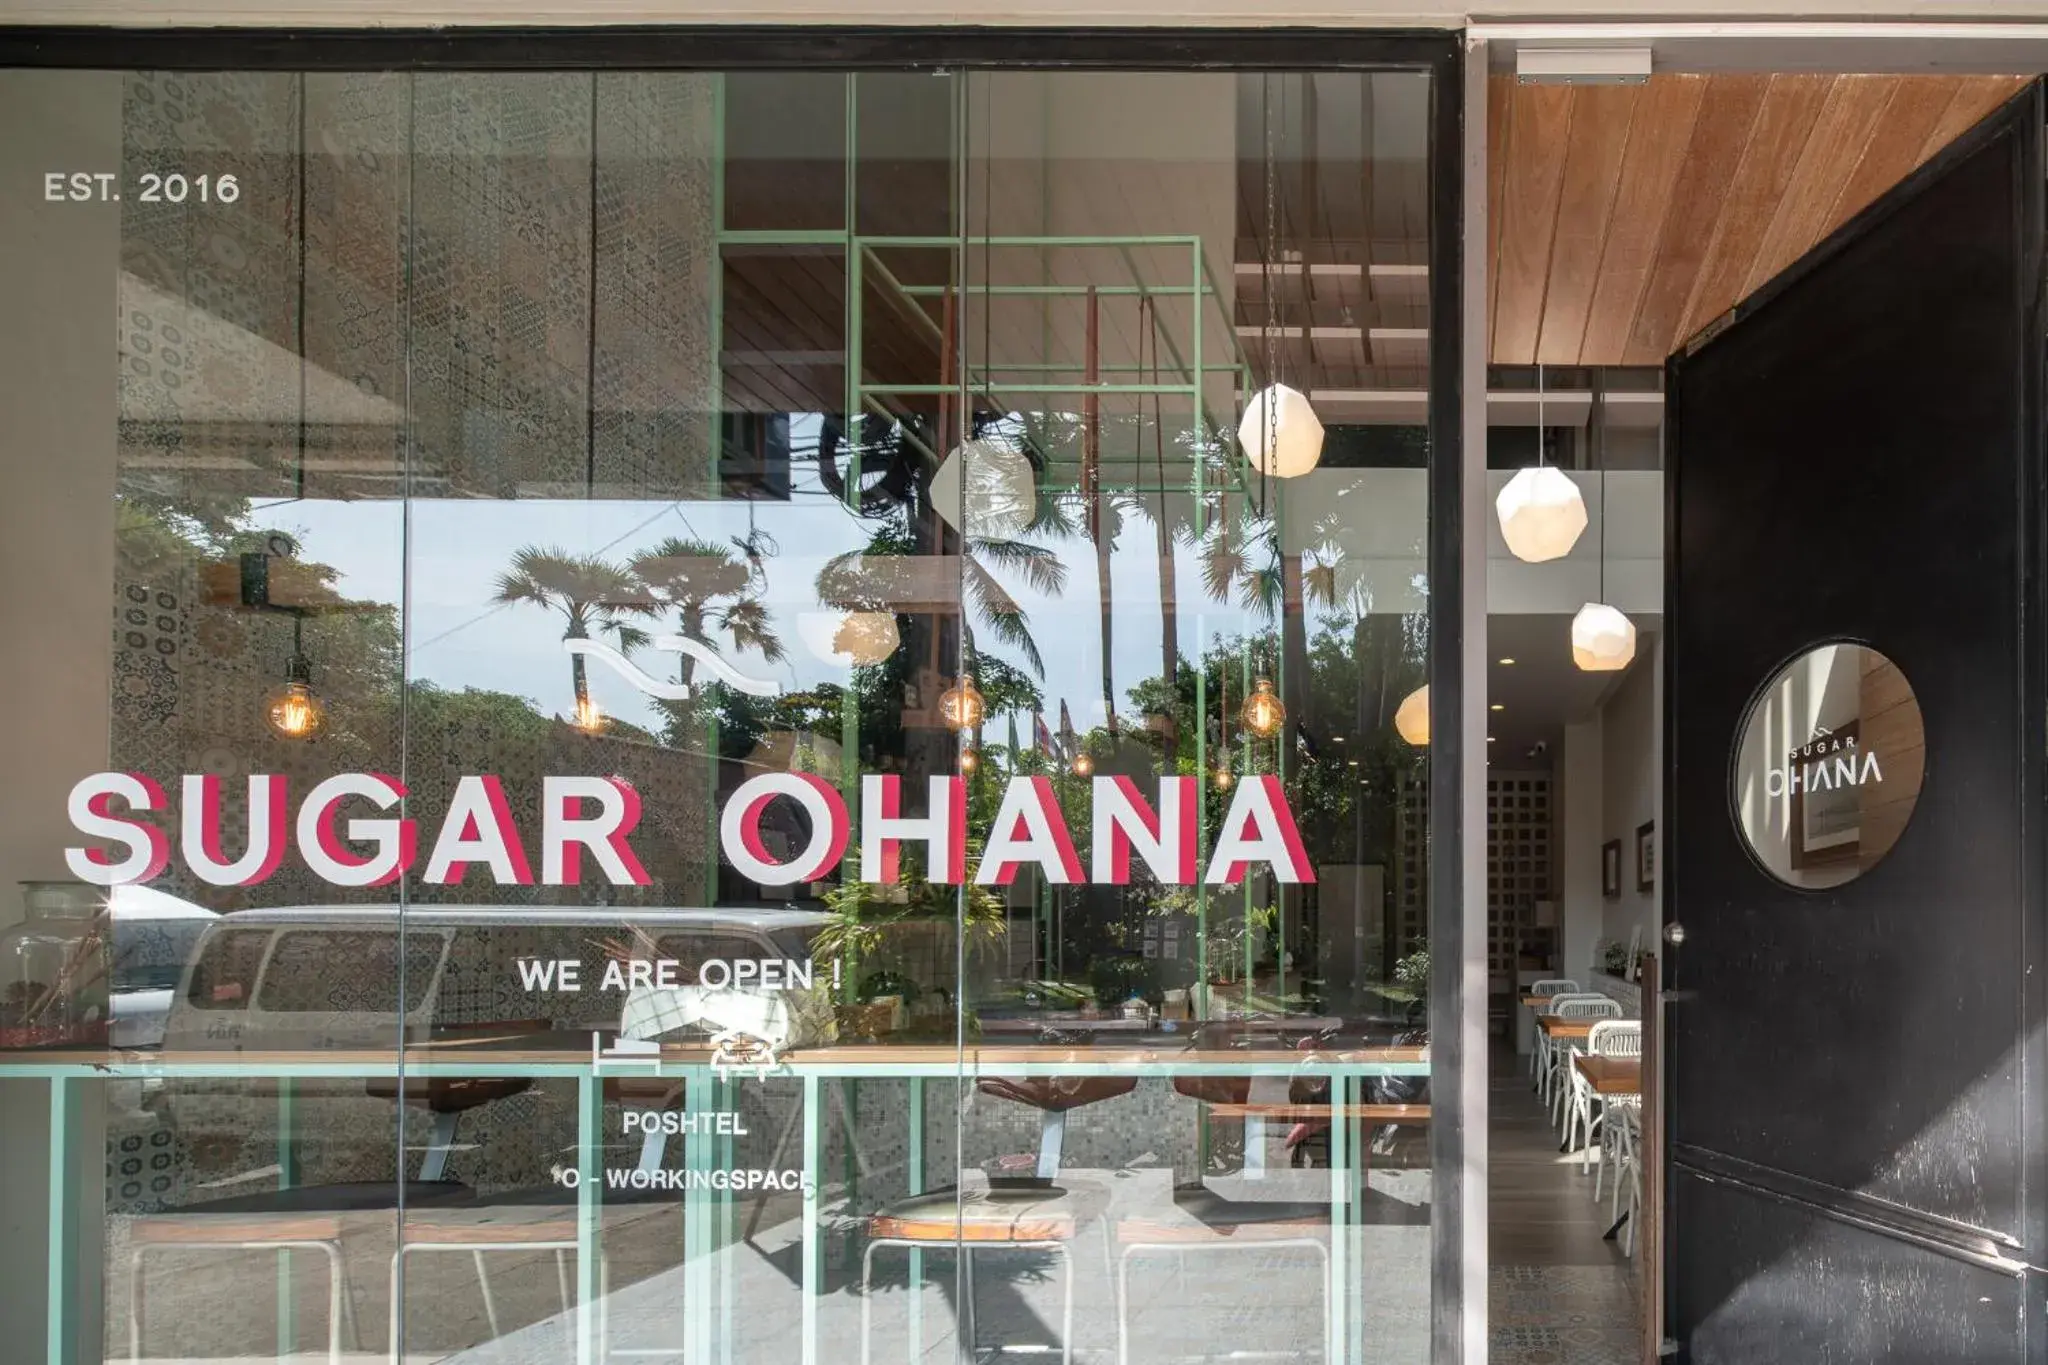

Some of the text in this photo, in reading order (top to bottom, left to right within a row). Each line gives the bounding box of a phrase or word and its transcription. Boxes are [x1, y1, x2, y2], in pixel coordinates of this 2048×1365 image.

[45, 172, 240, 203] EST. 2016
[1790, 736, 1855, 759] SUGAR
[1765, 752, 1883, 796] OHANA
[64, 771, 1317, 887] SUGAR OHANA
[517, 960, 581, 991] WE
[600, 960, 680, 991] ARE
[699, 959, 813, 991] OPEN
[623, 1111, 748, 1136] POSHTEL
